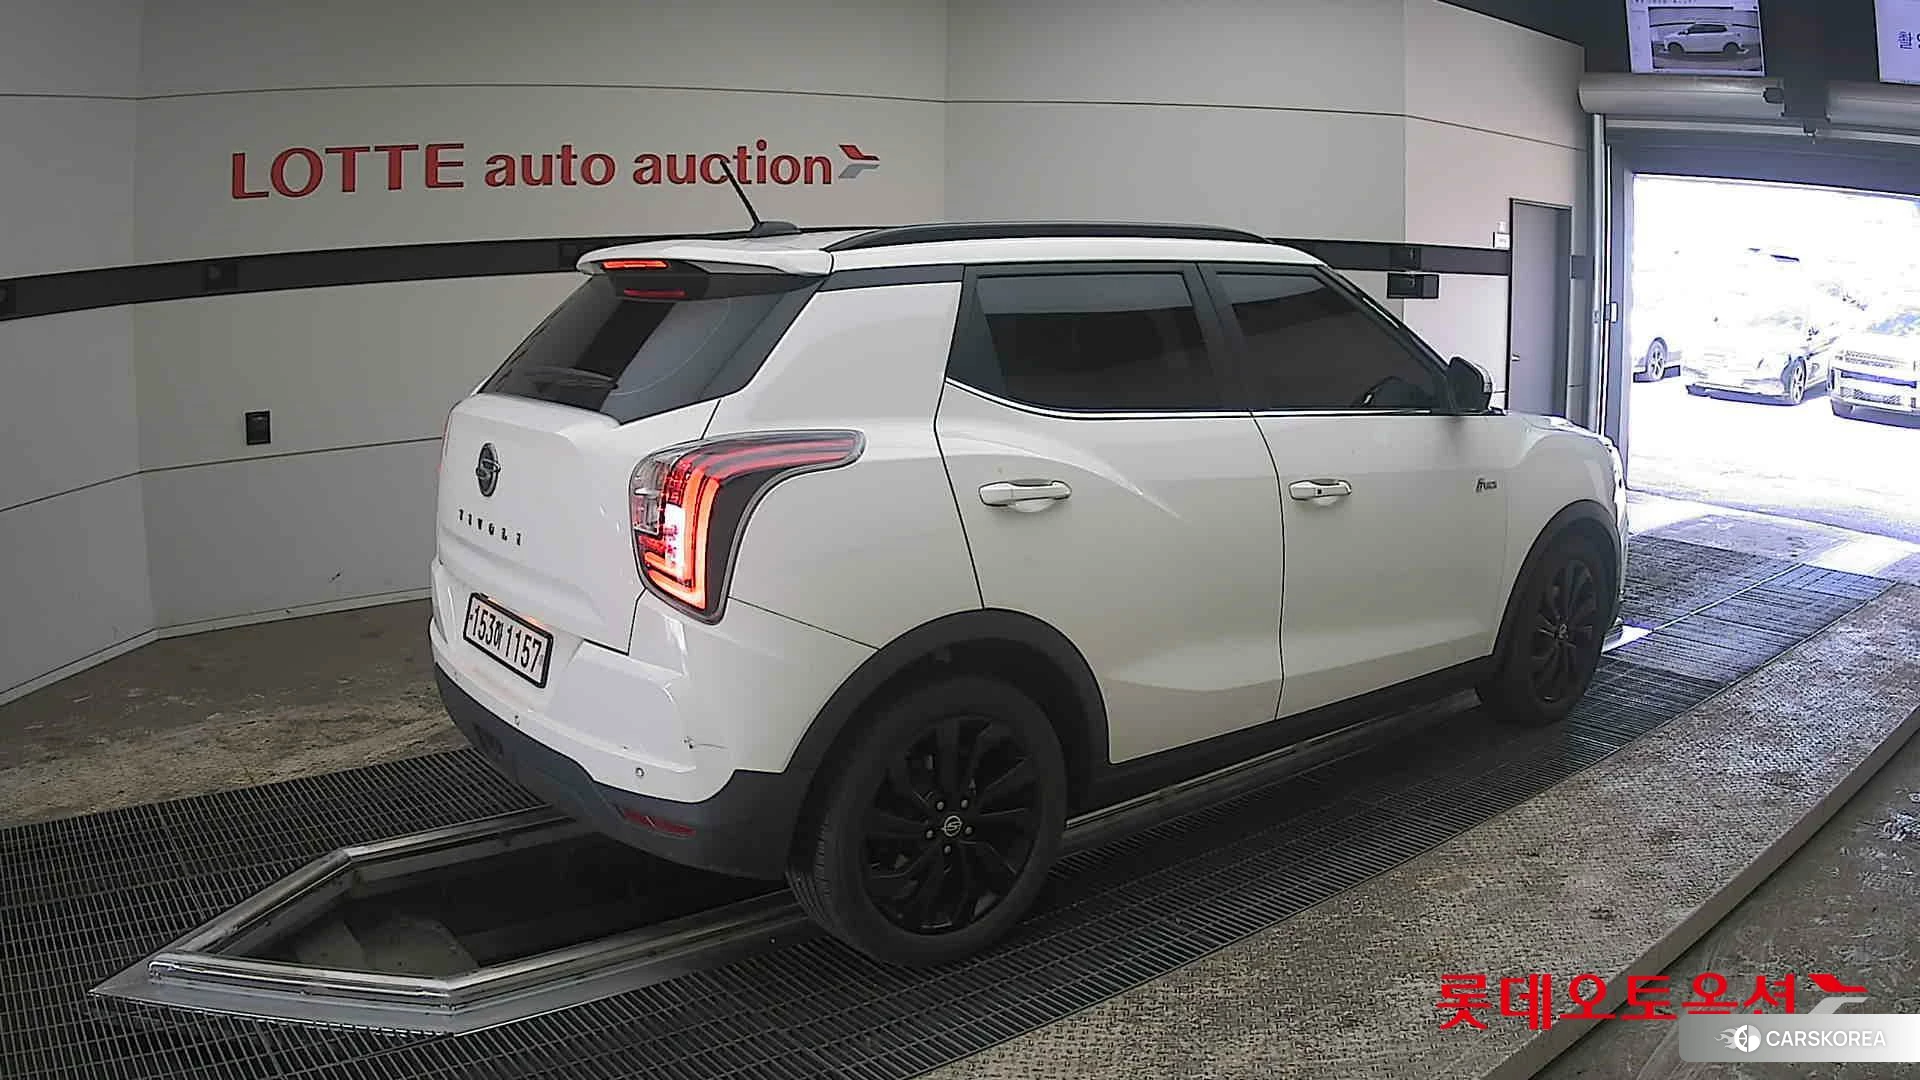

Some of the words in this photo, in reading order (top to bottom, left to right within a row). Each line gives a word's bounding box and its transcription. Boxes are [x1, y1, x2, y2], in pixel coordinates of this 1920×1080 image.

[231, 143, 464, 199] LOTTE
[484, 144, 616, 187] auto
[632, 138, 833, 185] auction
